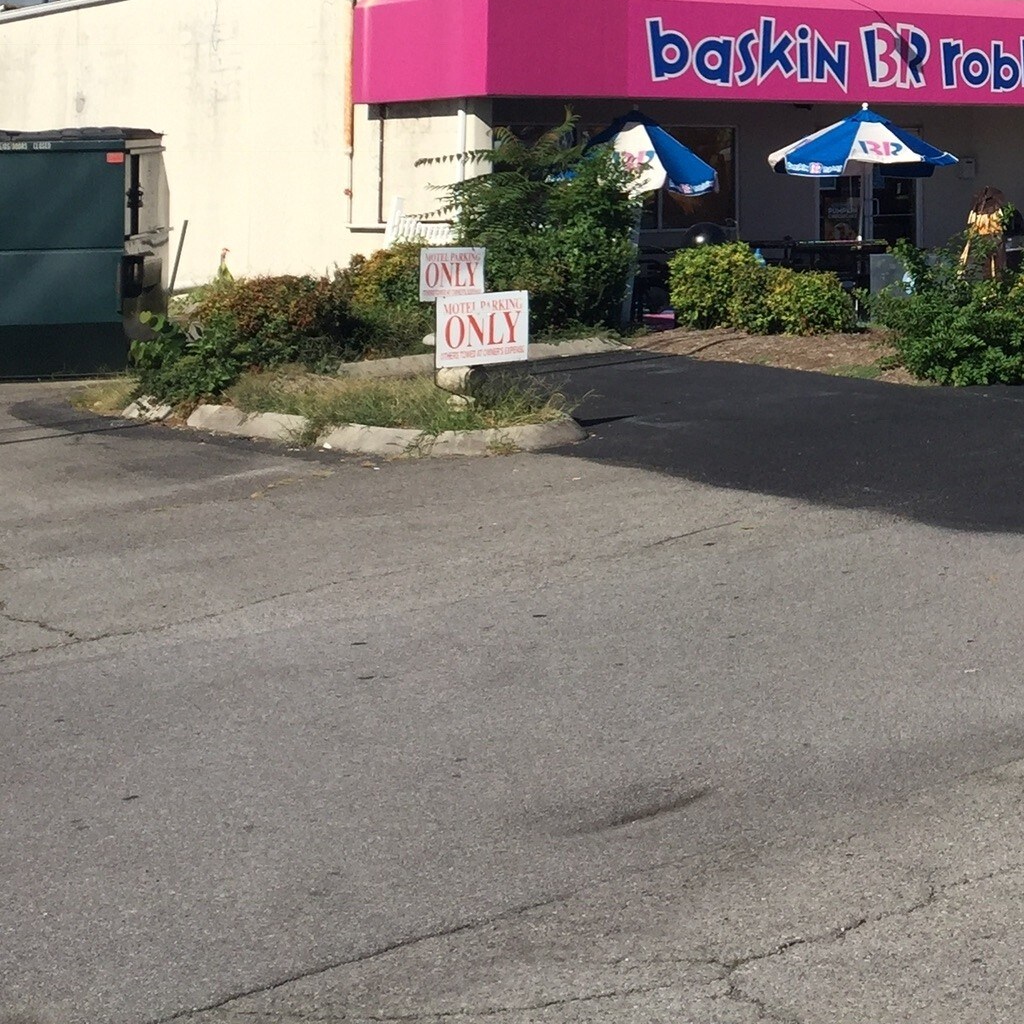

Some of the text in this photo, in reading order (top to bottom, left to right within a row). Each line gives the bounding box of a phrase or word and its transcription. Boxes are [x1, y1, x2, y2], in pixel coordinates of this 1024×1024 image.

[645, 16, 849, 94] baskin
[859, 22, 930, 90] BR
[426, 252, 480, 262] MOTEL PARKING
[425, 262, 478, 288] ONLY
[480, 297, 522, 311] PARKING
[445, 310, 521, 350] ONLY
